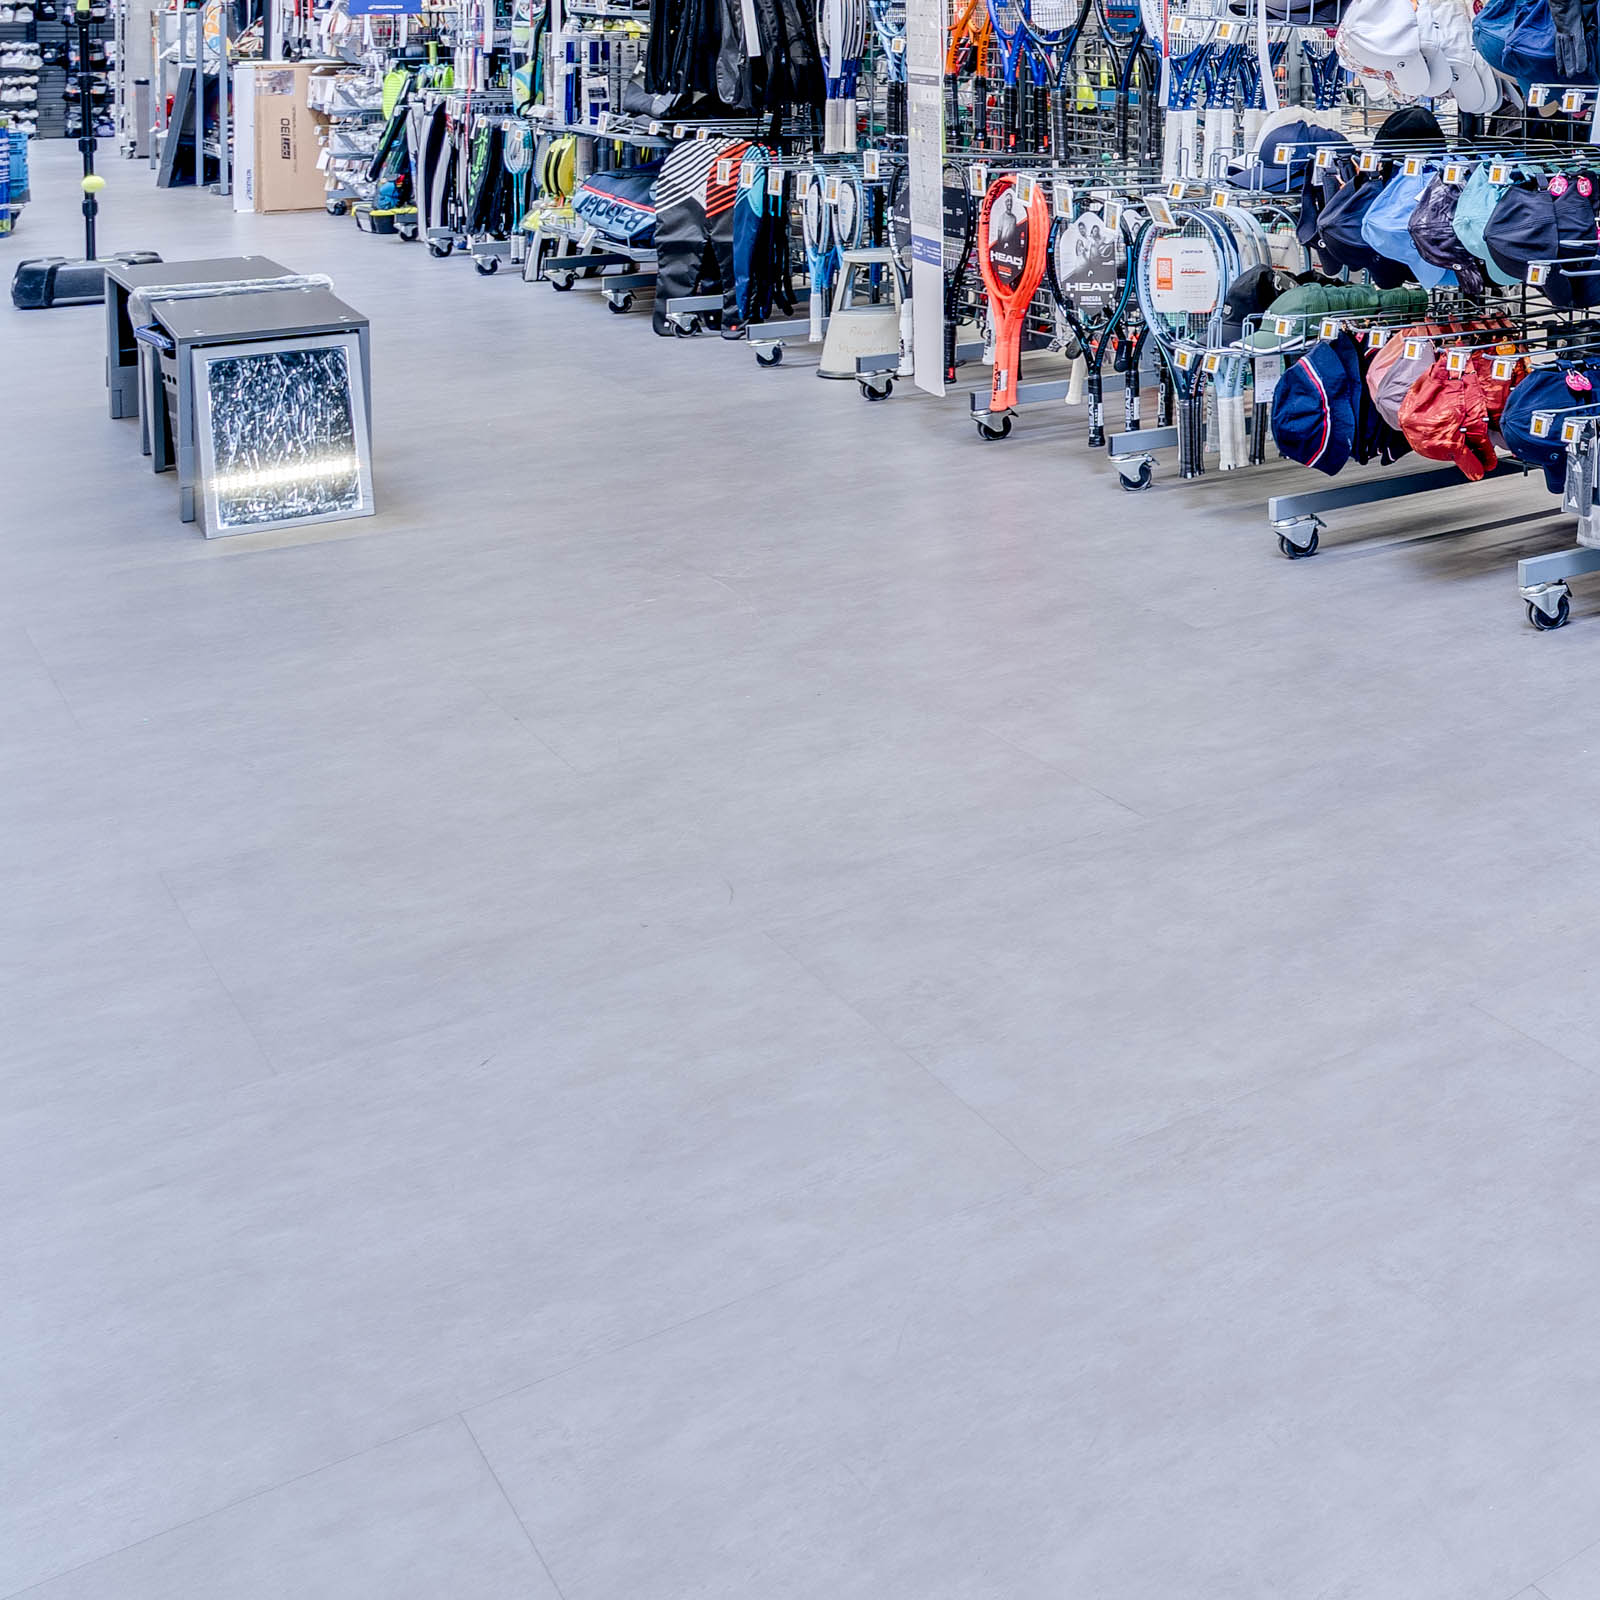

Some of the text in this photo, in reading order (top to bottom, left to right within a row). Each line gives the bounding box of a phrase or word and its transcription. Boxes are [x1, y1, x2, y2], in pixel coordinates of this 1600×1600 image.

[1177, 78, 1189, 107] EASY
[990, 250, 1022, 266] HEAD
[1066, 281, 1115, 293] HEAD
